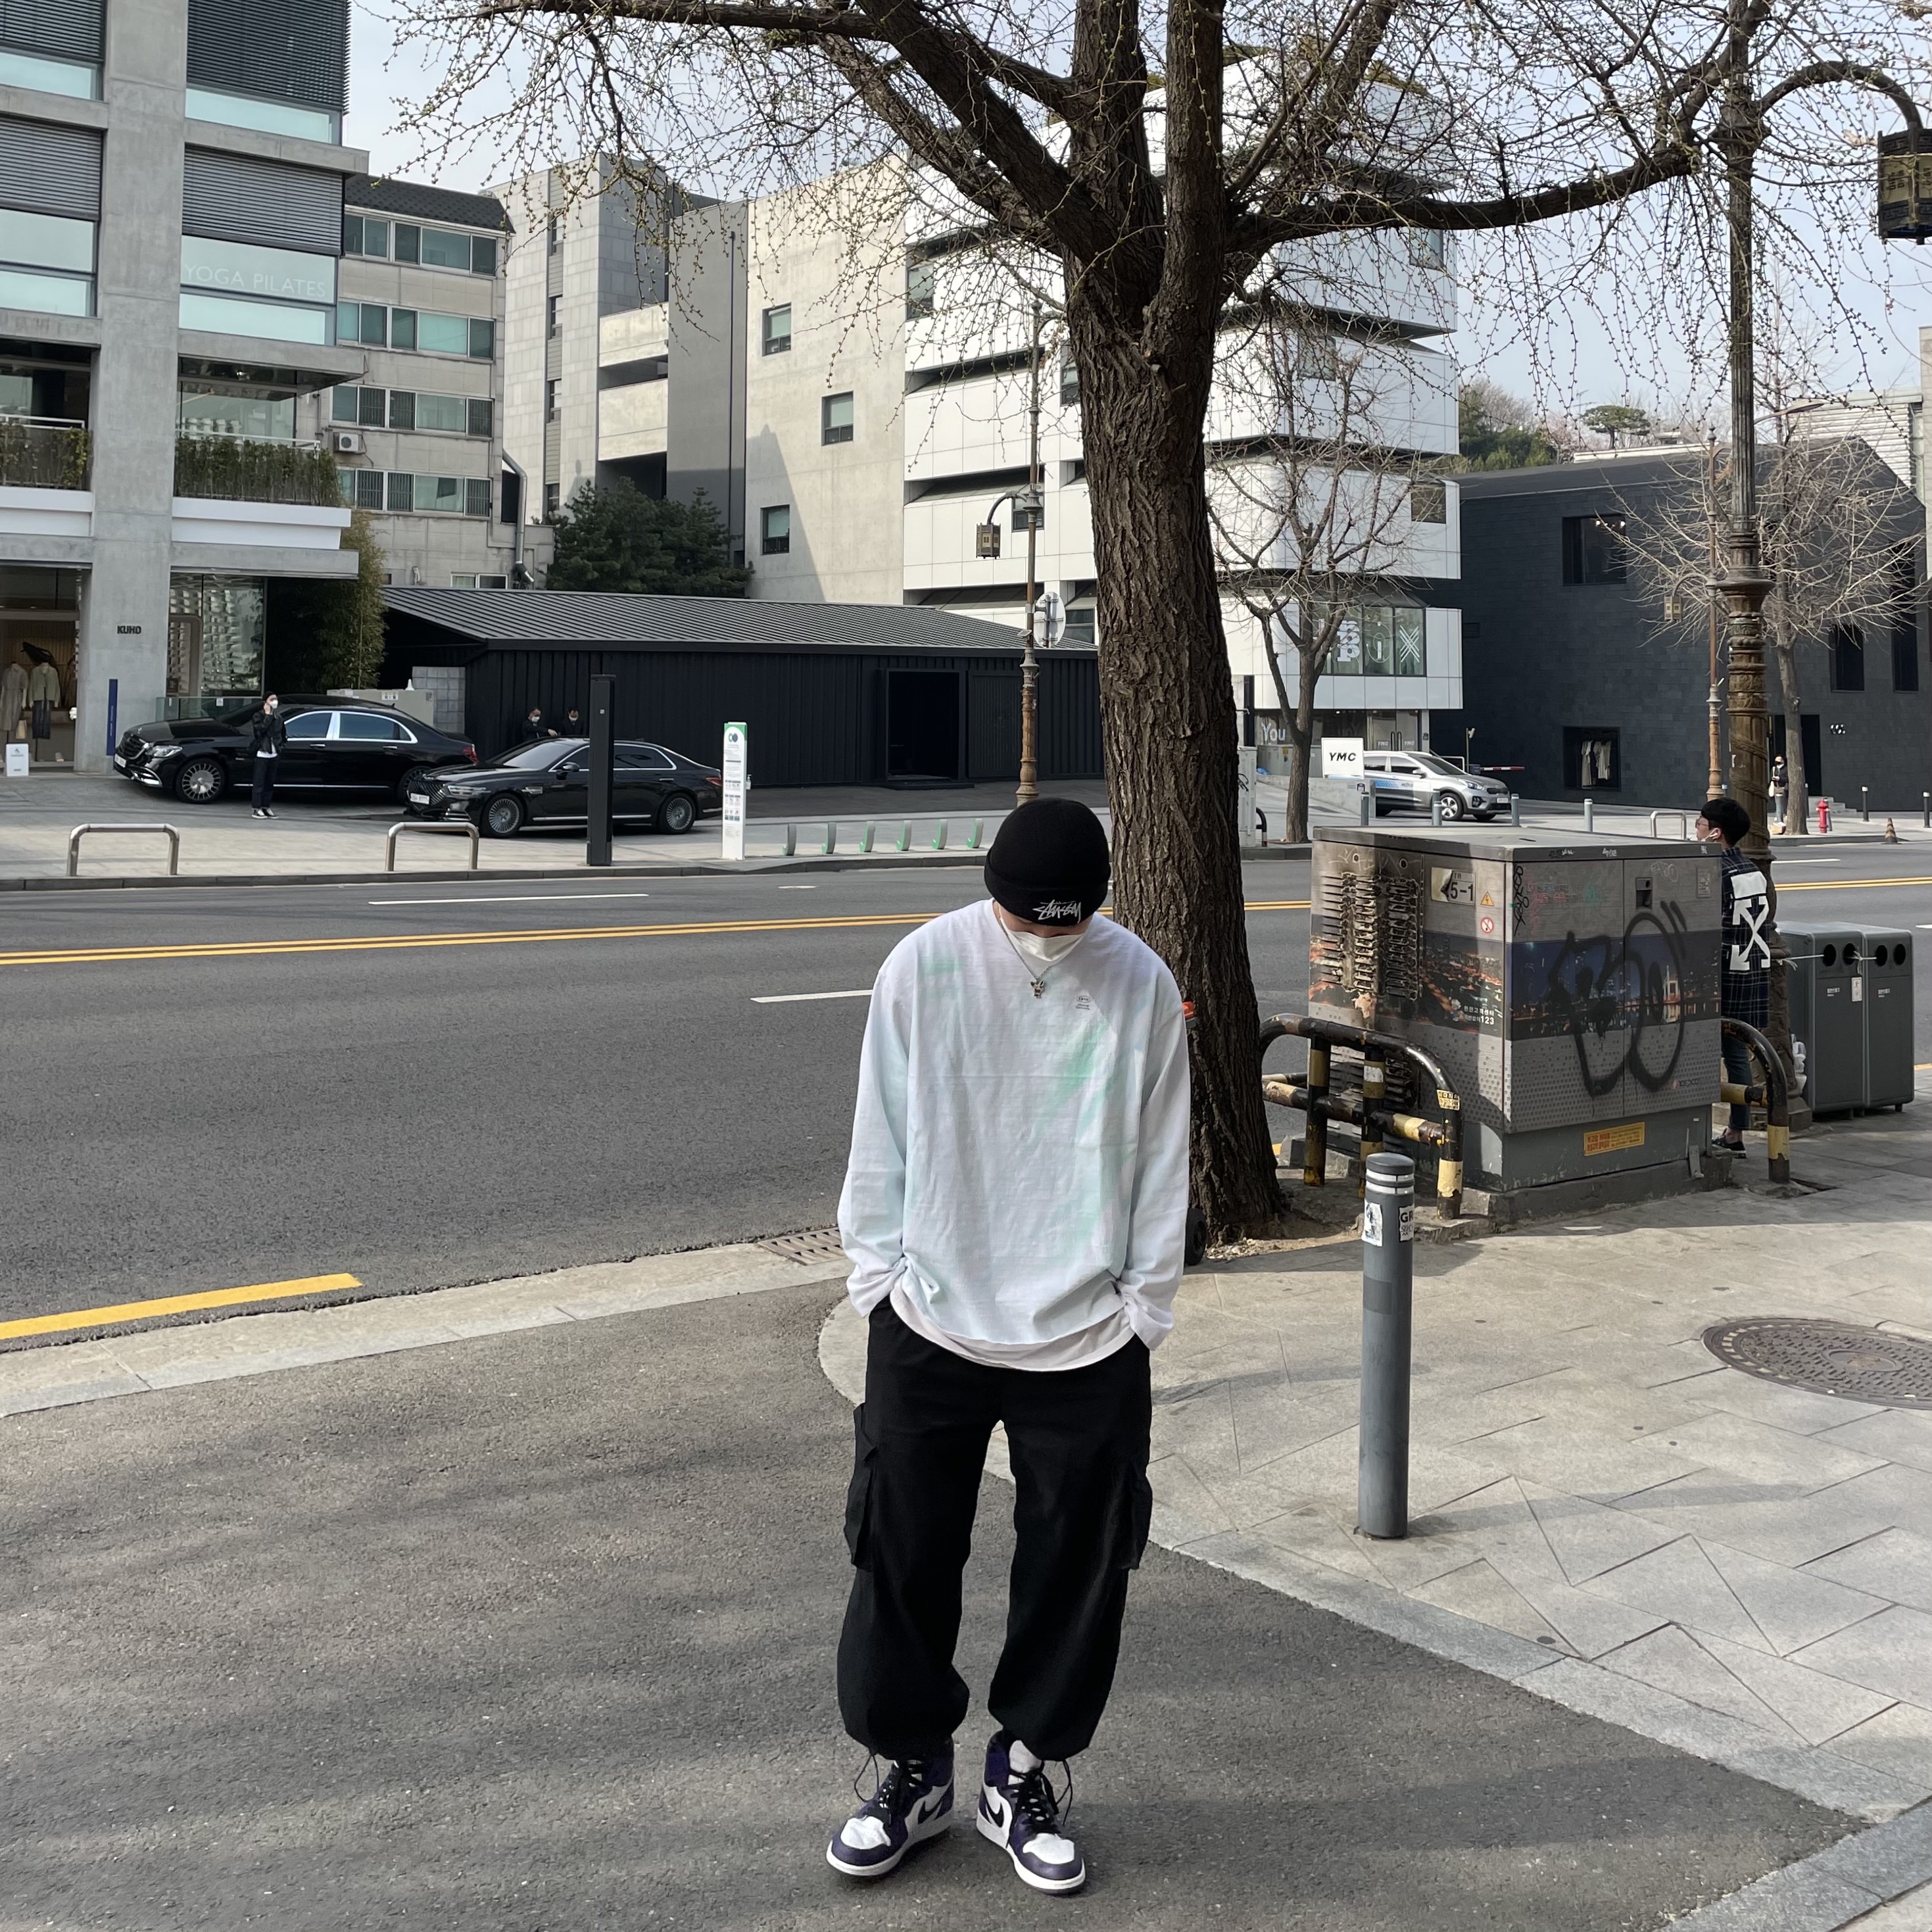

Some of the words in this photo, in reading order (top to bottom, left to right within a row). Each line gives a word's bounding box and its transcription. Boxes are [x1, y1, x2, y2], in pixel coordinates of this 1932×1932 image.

[185, 264, 245, 287] YOGA
[253, 273, 326, 297] PILATES
[117, 625, 141, 634] KUHO
[1261, 722, 1286, 742] You
[1329, 752, 1357, 761] YMC
